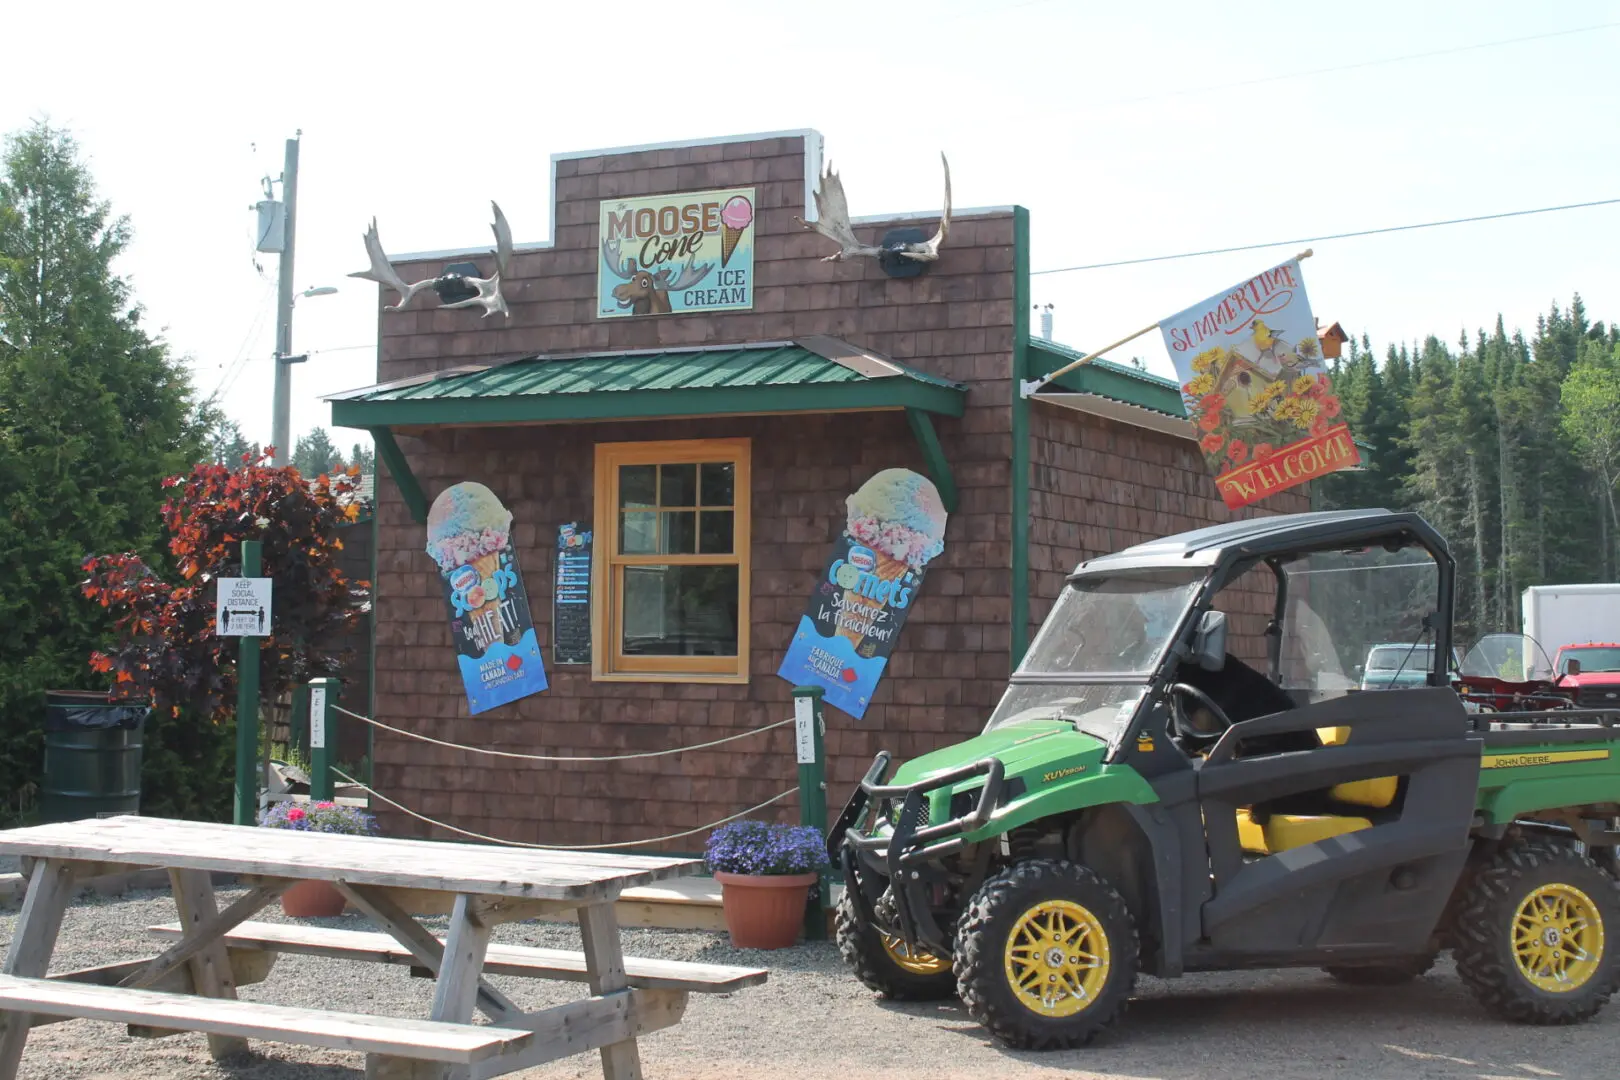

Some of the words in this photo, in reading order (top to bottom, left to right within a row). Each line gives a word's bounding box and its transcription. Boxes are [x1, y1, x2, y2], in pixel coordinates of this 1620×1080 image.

[607, 202, 720, 240] MOOSE
[639, 230, 704, 269] Cone
[717, 270, 746, 287] ICE
[683, 288, 746, 307] CREAM
[1170, 265, 1298, 352] SUMMERTIME
[1223, 433, 1352, 500] WELCOME
[231, 590, 255, 598] SOCIAL
[235, 581, 252, 589] KEEP
[818, 603, 831, 622] la
[830, 592, 889, 623] Savourez
[477, 598, 521, 644] HEAT!
[481, 666, 506, 682] CANADA
[813, 658, 841, 679] CANADA
[1495, 758, 1518, 767] JOHN
[1519, 755, 1550, 765] DEERE
